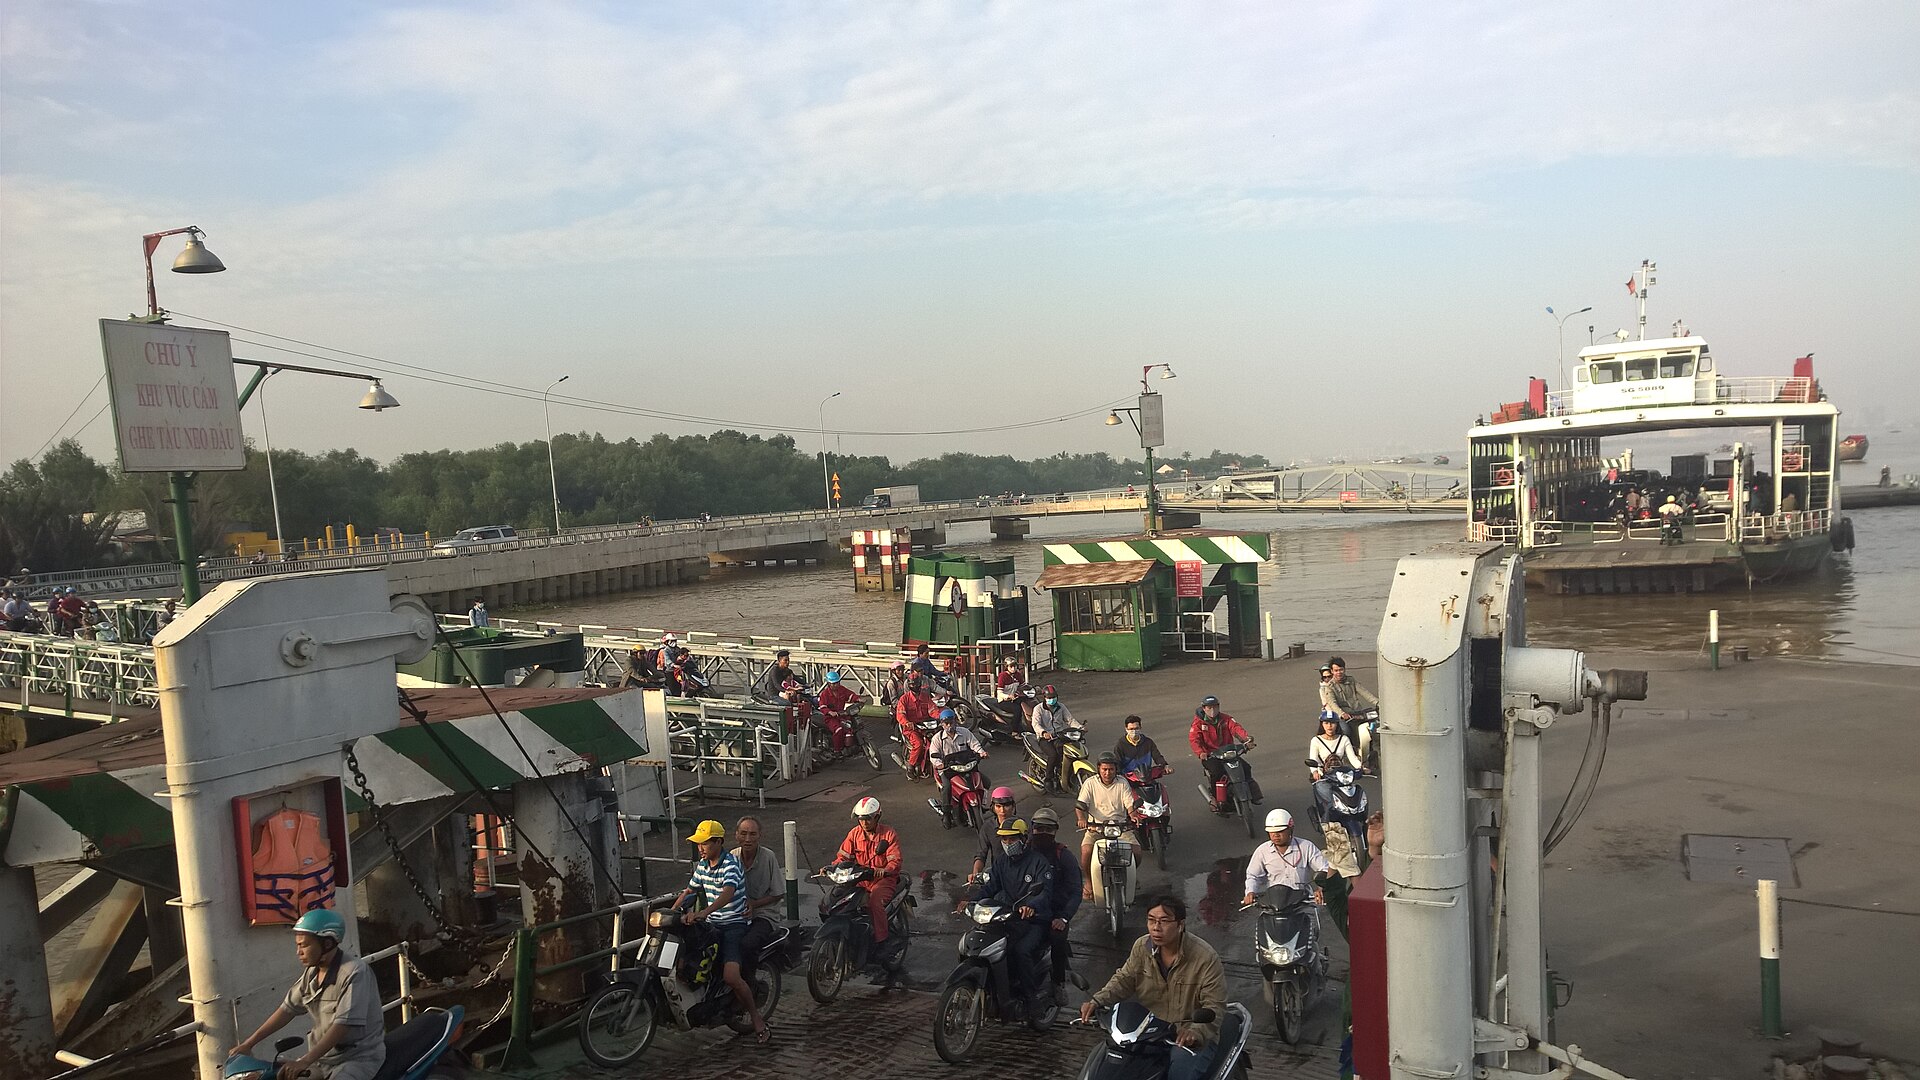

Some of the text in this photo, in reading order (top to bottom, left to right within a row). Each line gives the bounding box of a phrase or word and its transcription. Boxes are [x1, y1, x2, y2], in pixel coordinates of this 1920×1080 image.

[145, 336, 197, 367] CHÚ Ý
[135, 384, 163, 406] KHU
[129, 426, 154, 449] GHE
[157, 419, 181, 449] TÀU
[184, 427, 208, 449] NEO
